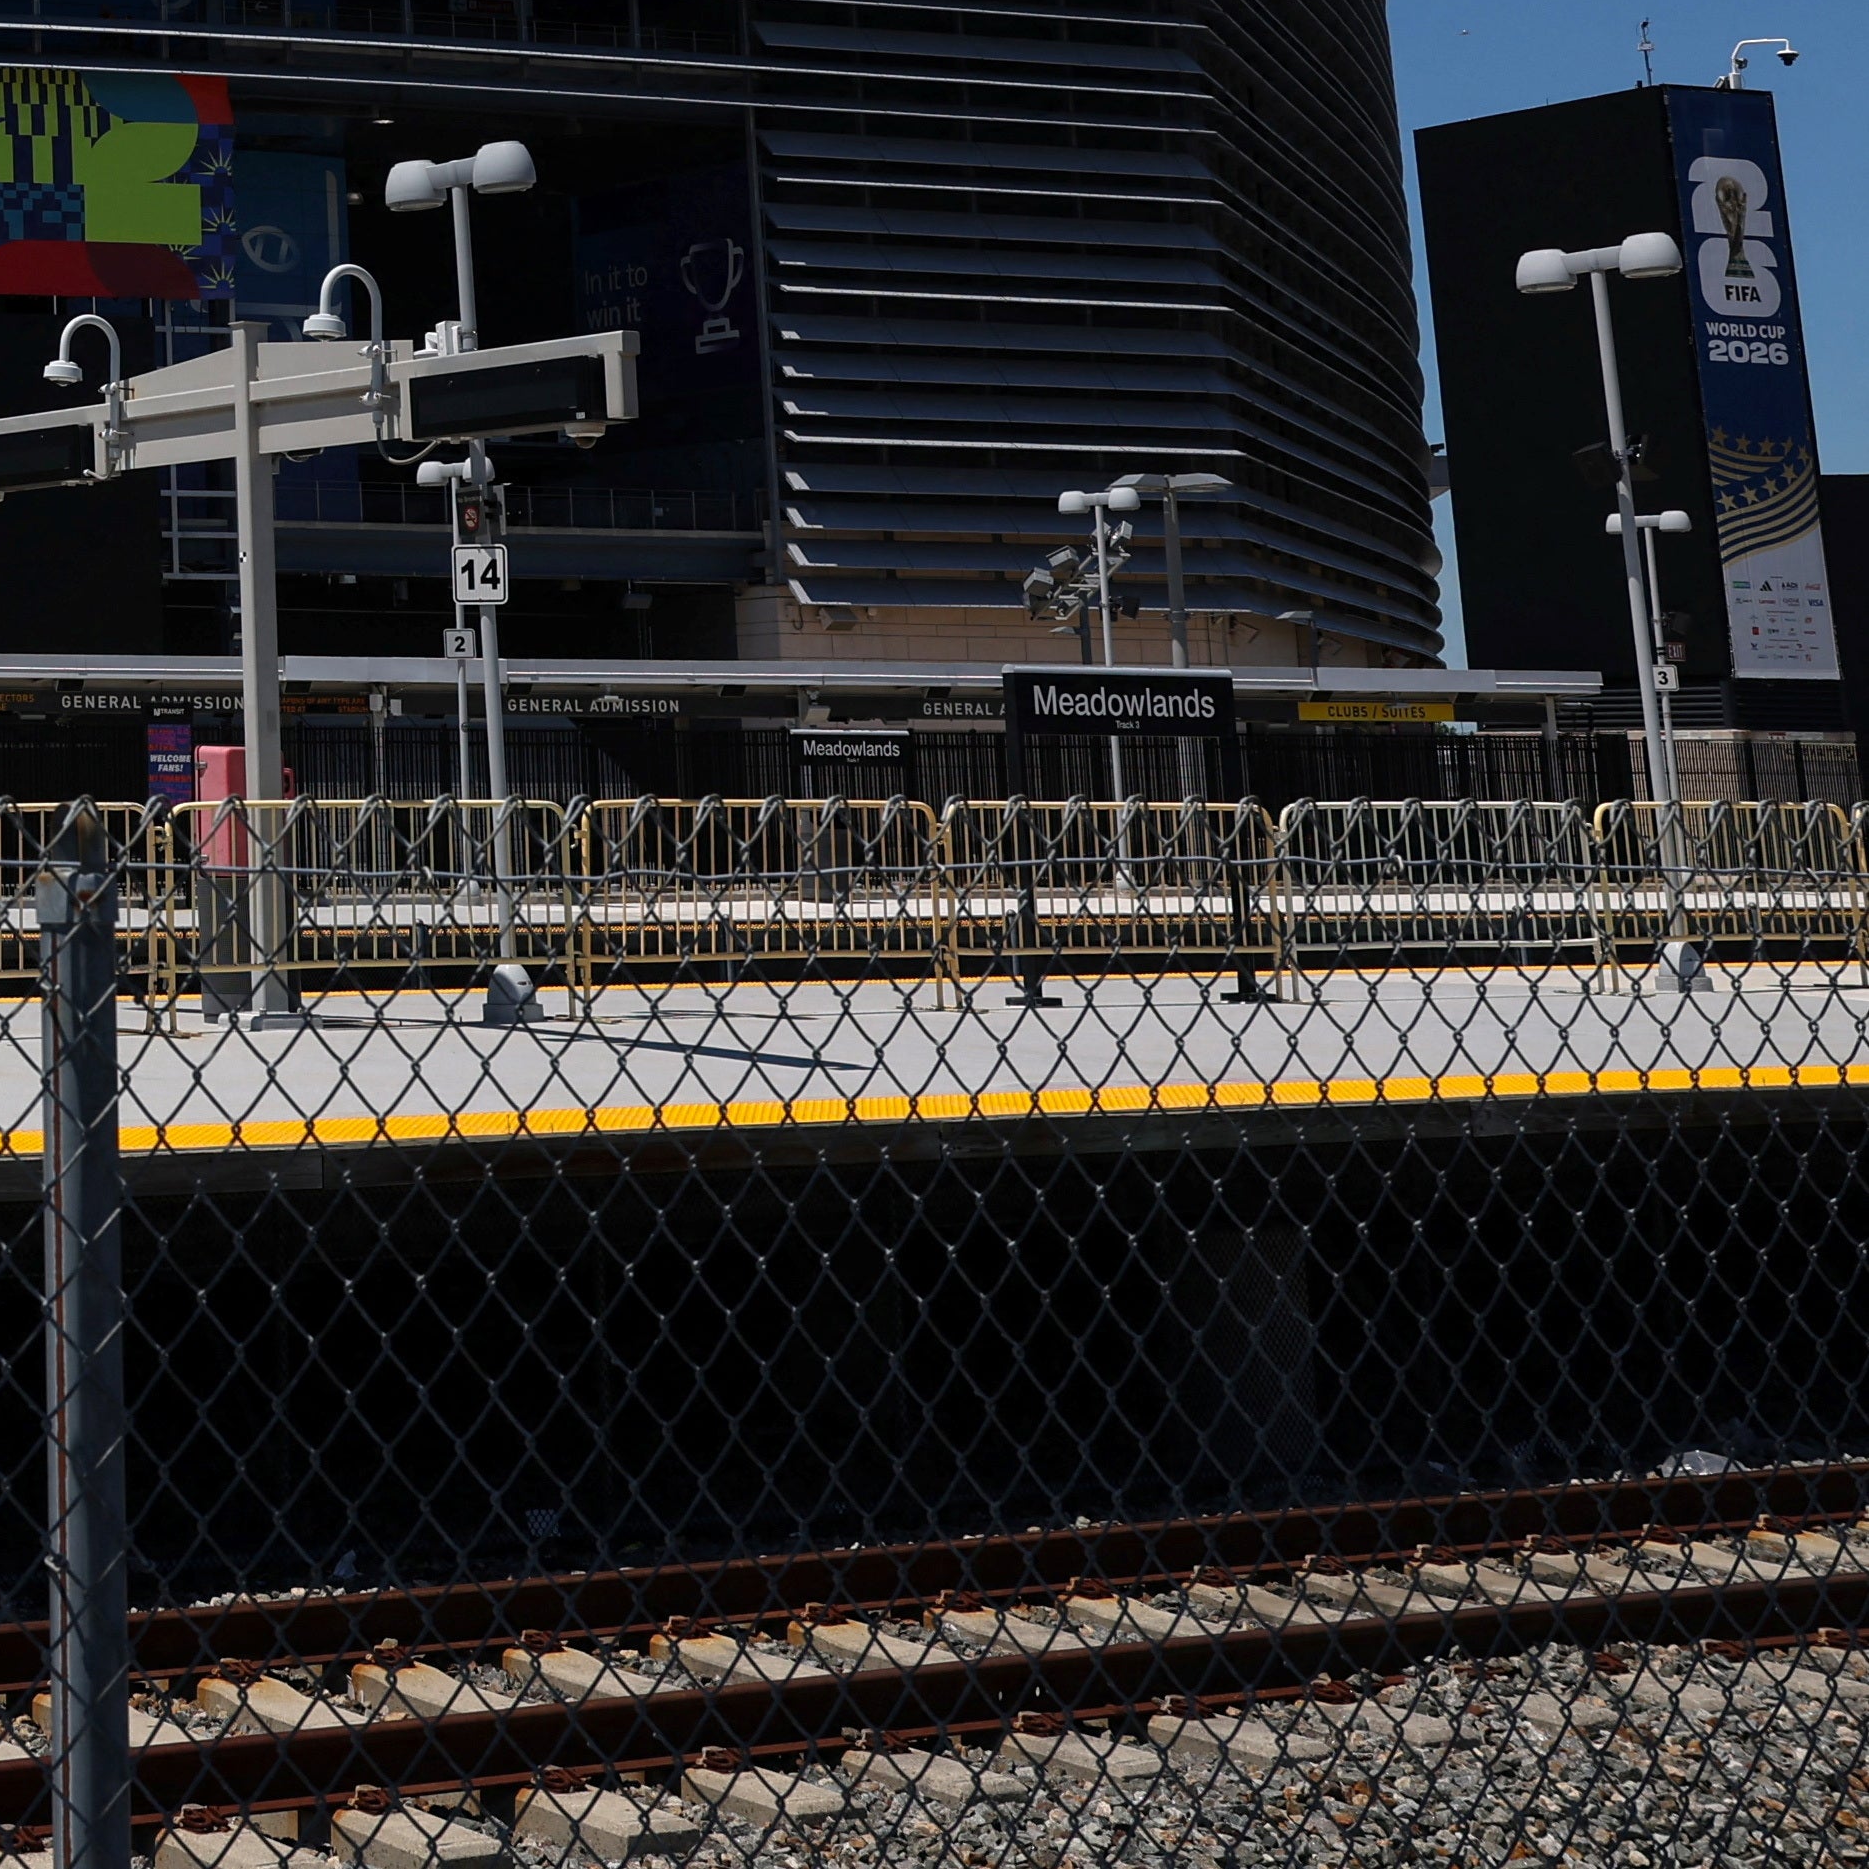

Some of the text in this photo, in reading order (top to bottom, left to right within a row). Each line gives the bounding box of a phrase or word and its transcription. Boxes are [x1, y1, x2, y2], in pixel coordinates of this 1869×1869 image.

[585, 263, 648, 296] In it to
[1724, 285, 1762, 303] FIFA
[586, 296, 642, 328] win it
[1705, 321, 1786, 340] WORLD CUP
[1707, 340, 1789, 366] 2026
[461, 559, 501, 591] 14
[1808, 599, 1824, 607] VISA
[454, 636, 466, 653] 2
[1668, 644, 1683, 659] EXIT
[1658, 671, 1669, 685] 3
[61, 695, 141, 709] GENERAL
[507, 699, 680, 713] GENERAL ADMISSION
[923, 702, 994, 716] GENERAL
[1033, 685, 1216, 719] Meadowlands
[1327, 706, 1368, 718] CLUBS
[1381, 706, 1426, 719] SUITES
[1116, 720, 1133, 729] Track
[803, 740, 901, 758] Meadowlands
[150, 754, 191, 763] WELCOME
[158, 763, 184, 772] FANS!
